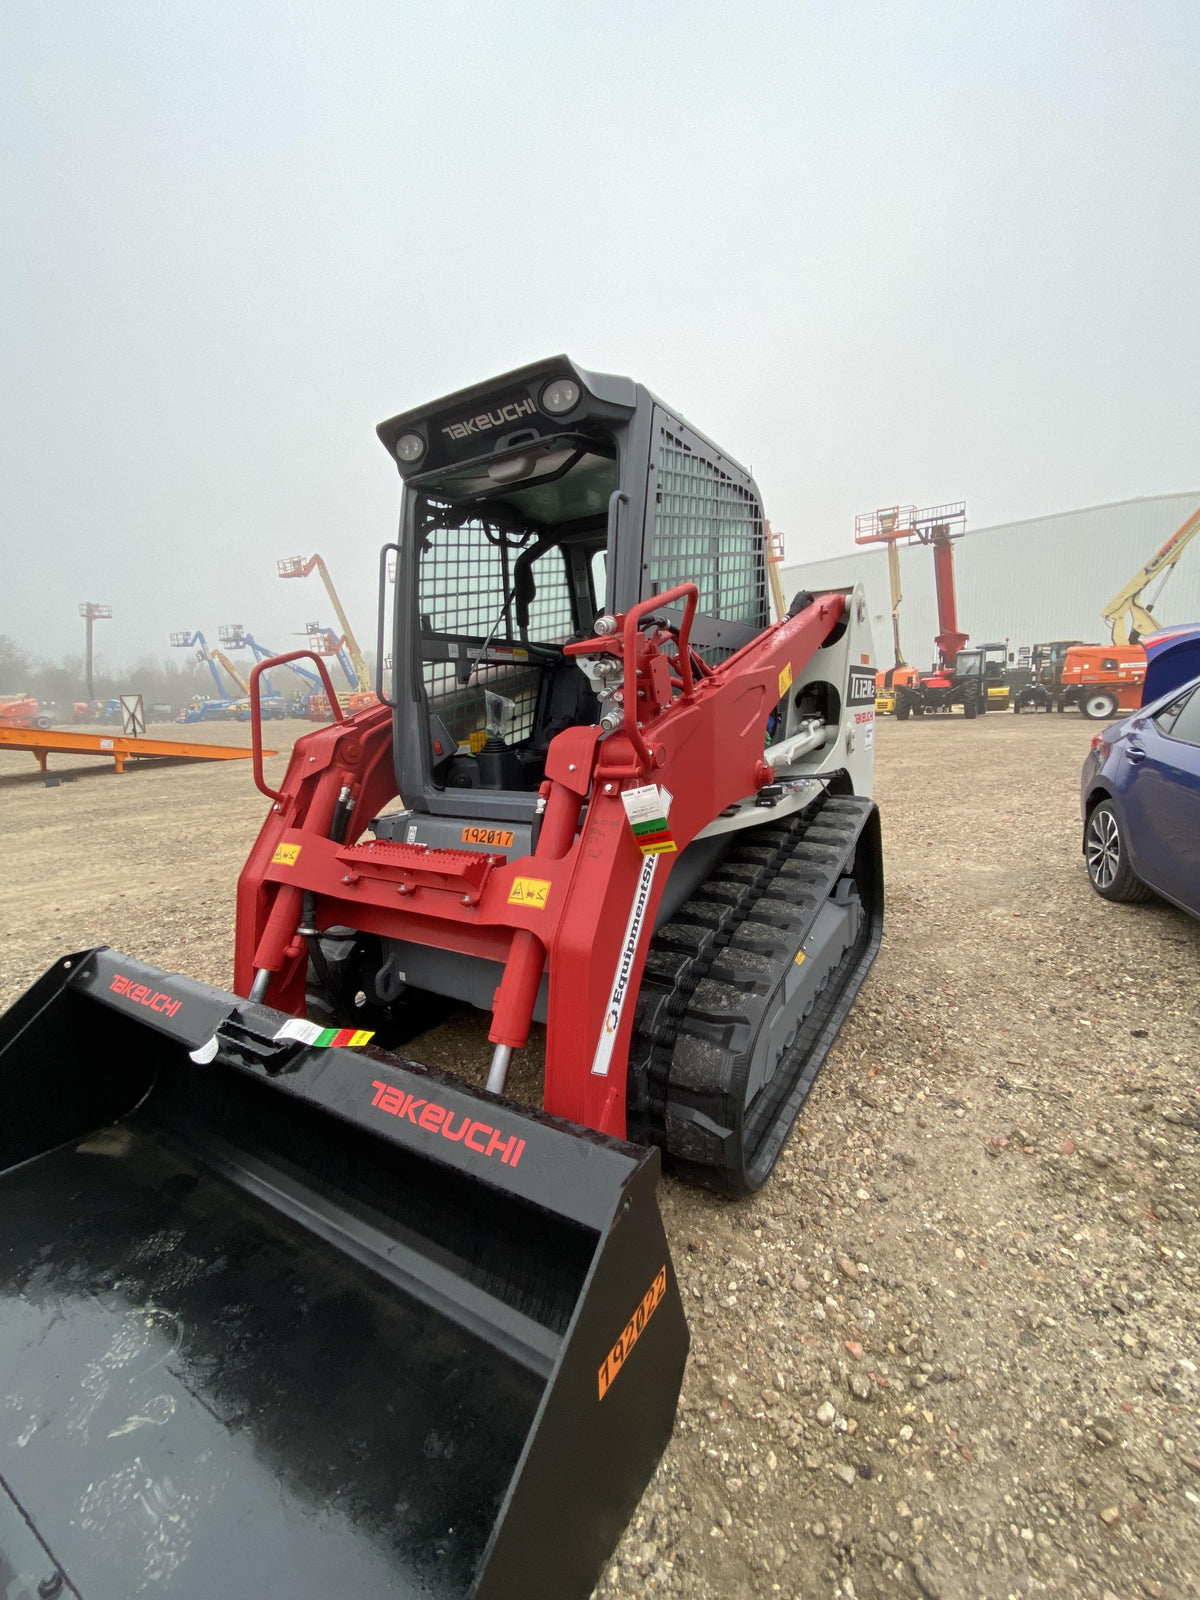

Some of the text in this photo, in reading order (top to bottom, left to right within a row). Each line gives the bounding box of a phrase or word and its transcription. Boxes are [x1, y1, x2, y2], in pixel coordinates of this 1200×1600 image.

[464, 828, 514, 846] 192017
[612, 853, 656, 1006] EquipmentSh
[601, 1270, 665, 1388] 192022
